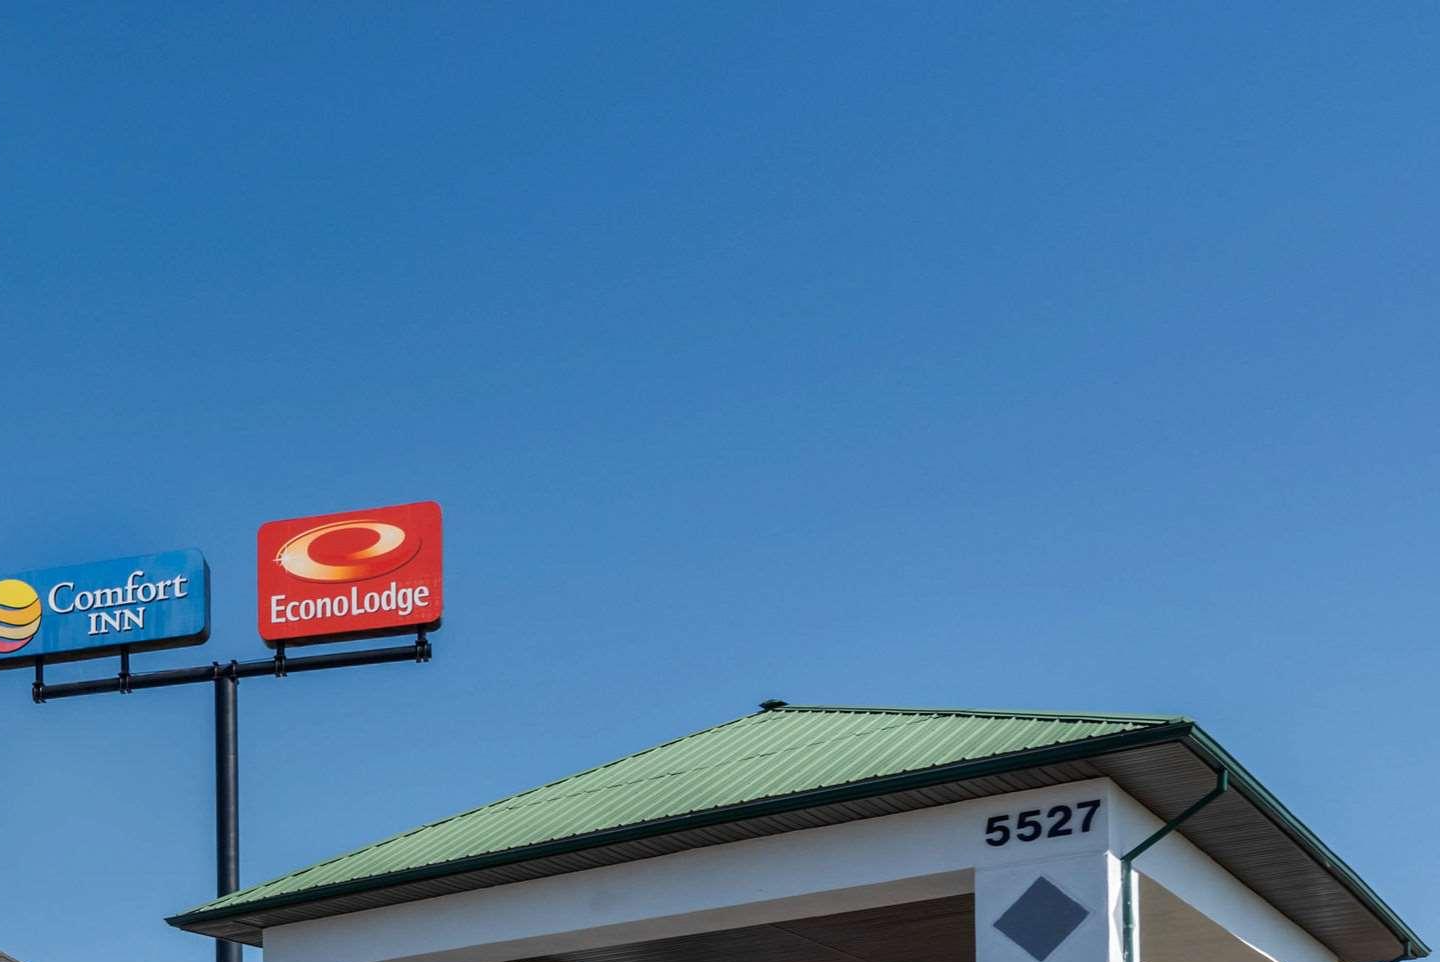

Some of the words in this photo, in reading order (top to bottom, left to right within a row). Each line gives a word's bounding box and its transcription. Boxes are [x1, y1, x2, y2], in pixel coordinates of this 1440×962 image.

[48, 570, 189, 614] Comfort
[270, 582, 430, 624] EconoLodge
[88, 606, 146, 636] INN
[985, 799, 1101, 847] 5527
